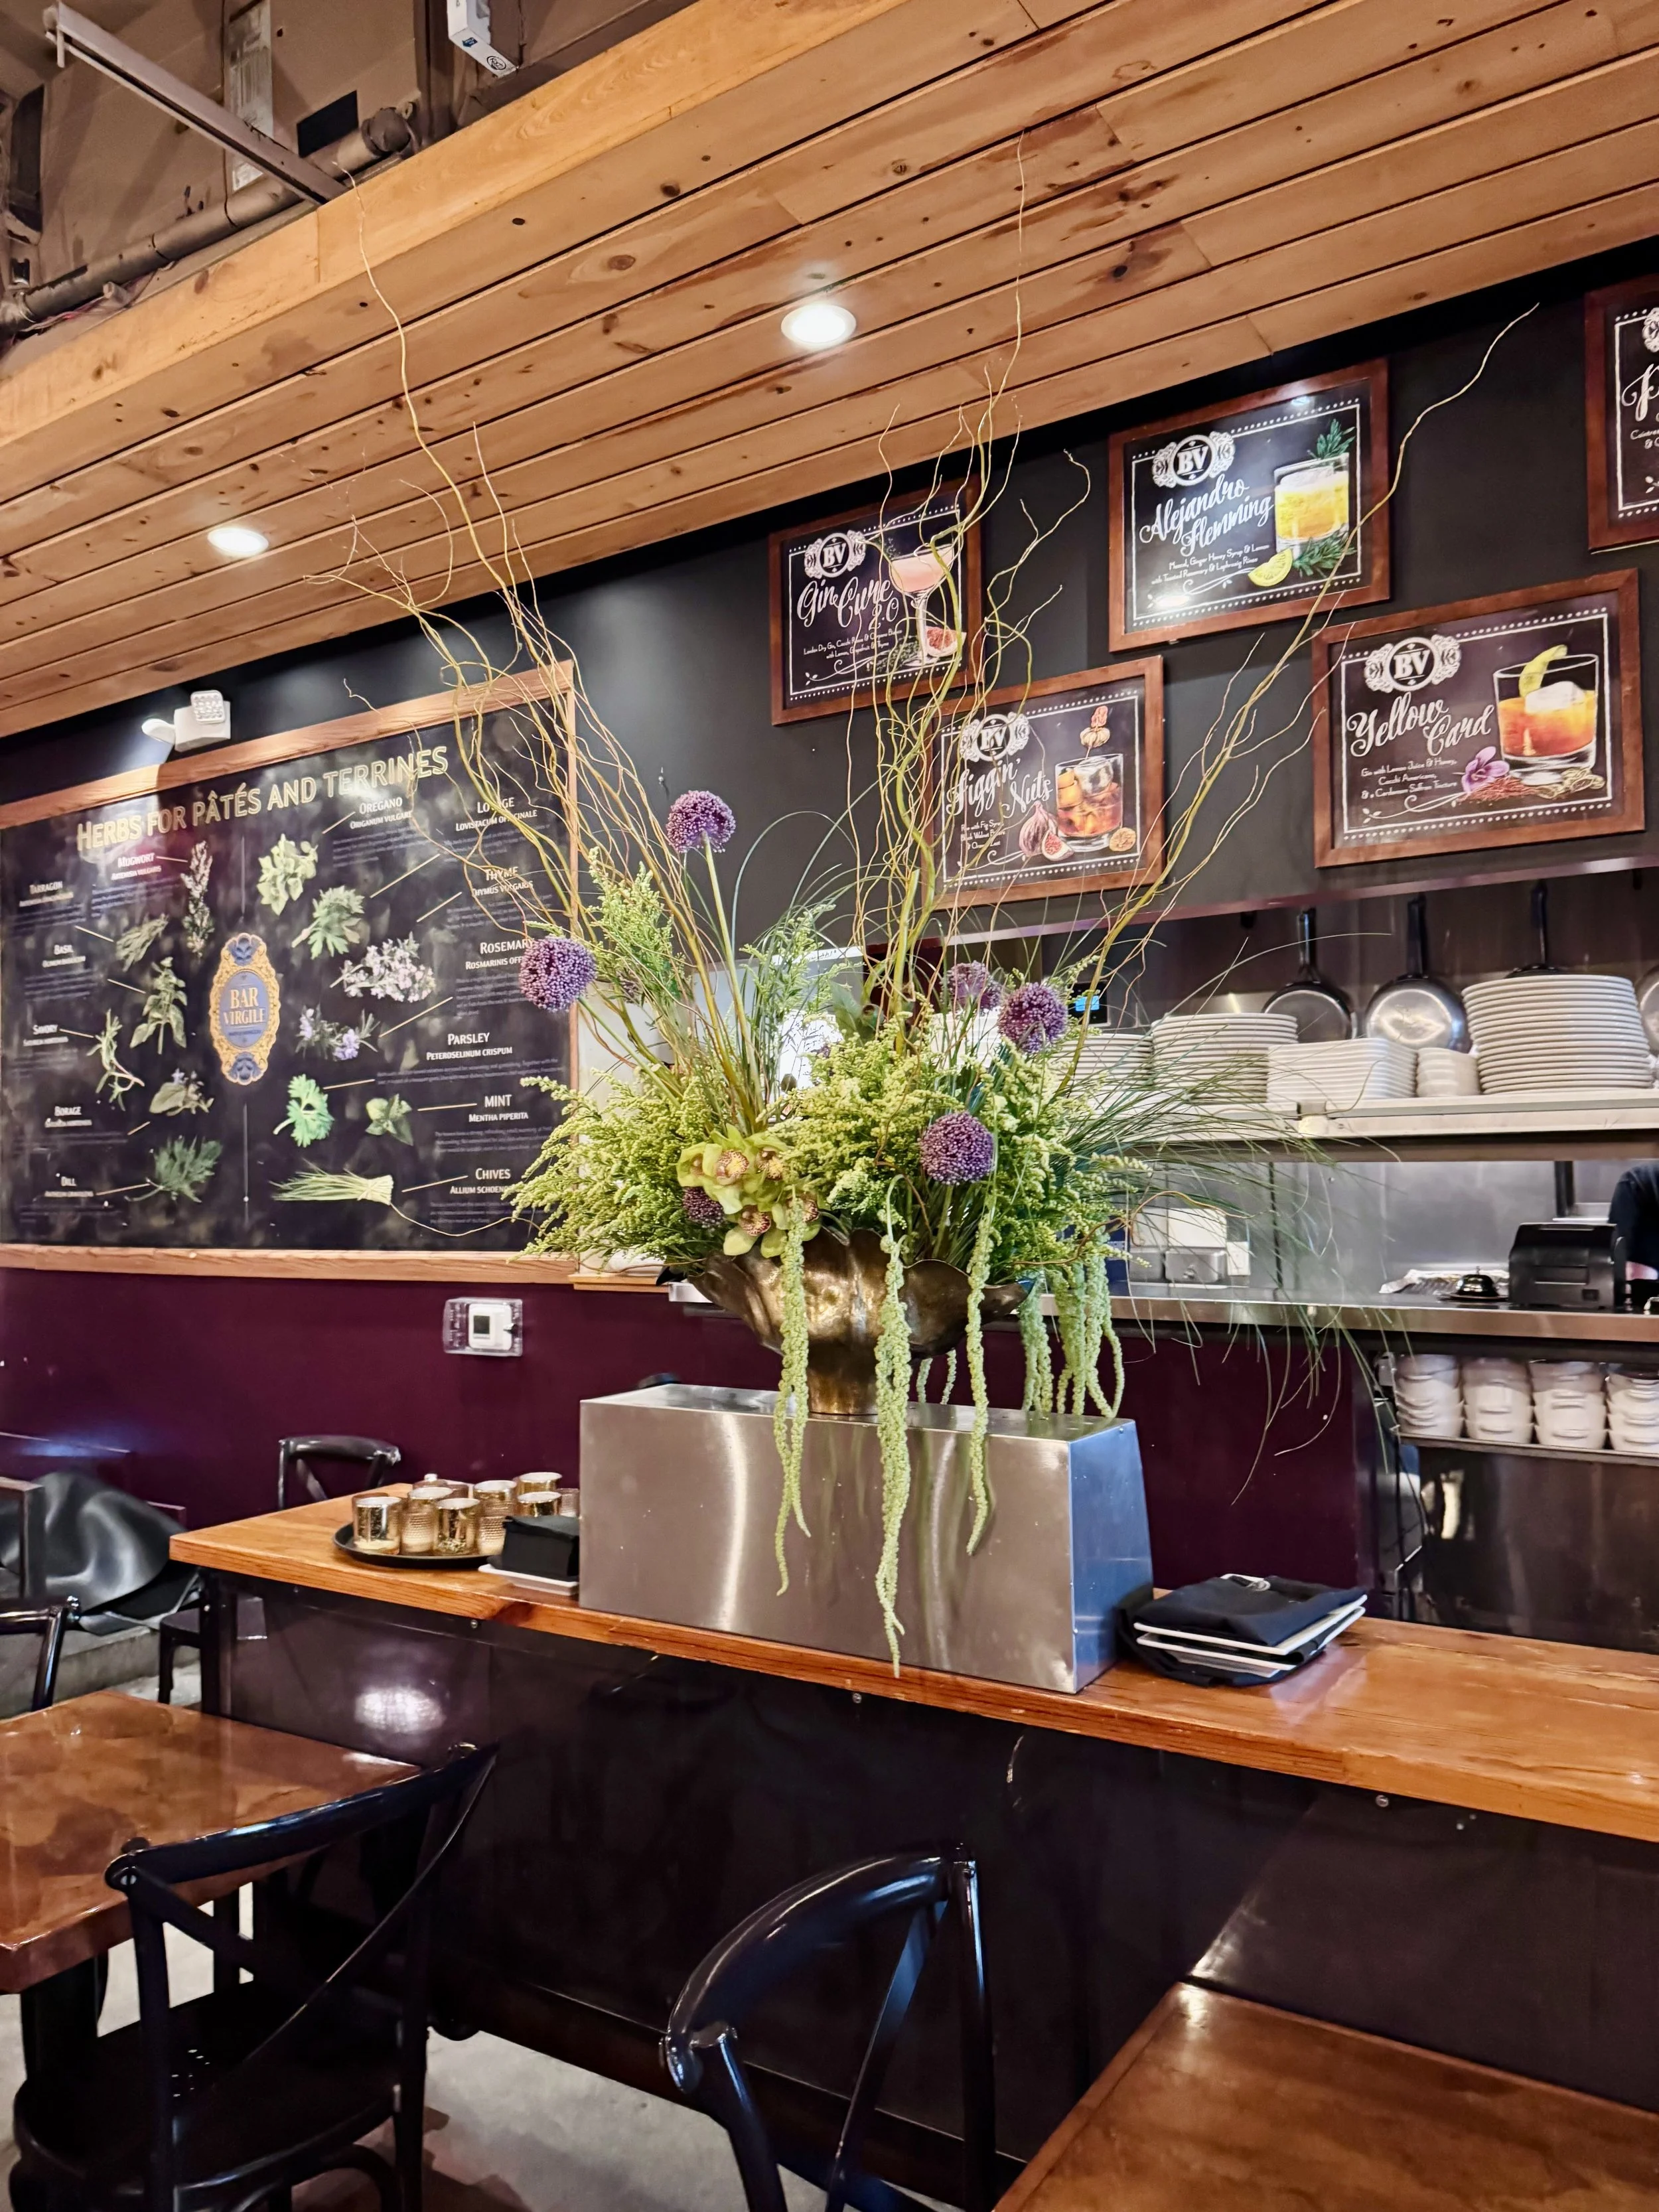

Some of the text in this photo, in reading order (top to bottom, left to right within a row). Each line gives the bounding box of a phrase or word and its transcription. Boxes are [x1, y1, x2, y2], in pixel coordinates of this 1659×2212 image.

[1177, 446, 1208, 475] BV
[1139, 474, 1250, 544] Alejandro
[1180, 495, 1274, 557] Flemming
[822, 544, 845, 566] BV
[797, 579, 837, 627] Gin
[1394, 649, 1430, 678] BV
[1346, 692, 1449, 757] Yellow
[1423, 704, 1494, 756] Card
[77, 746, 448, 851] HERBS FOR PÂTÉS AND TERRINES
[1001, 770, 1053, 818] Nuts
[359, 797, 403, 814] OREGANO
[477, 797, 515, 814] LOGE
[230, 987, 259, 1009] BAR
[223, 1009, 265, 1025] VIRGILE
[447, 1032, 490, 1046] PARSLEY
[482, 1046, 513, 1057] CRISPUM
[54, 1106, 82, 1116] BORAGE
[484, 1094, 512, 1108] MINT
[469, 1112, 529, 1123] MENTHA PIPERITA
[475, 1167, 511, 1180] CHIVES
[449, 1185, 476, 1195] ALLIUM
